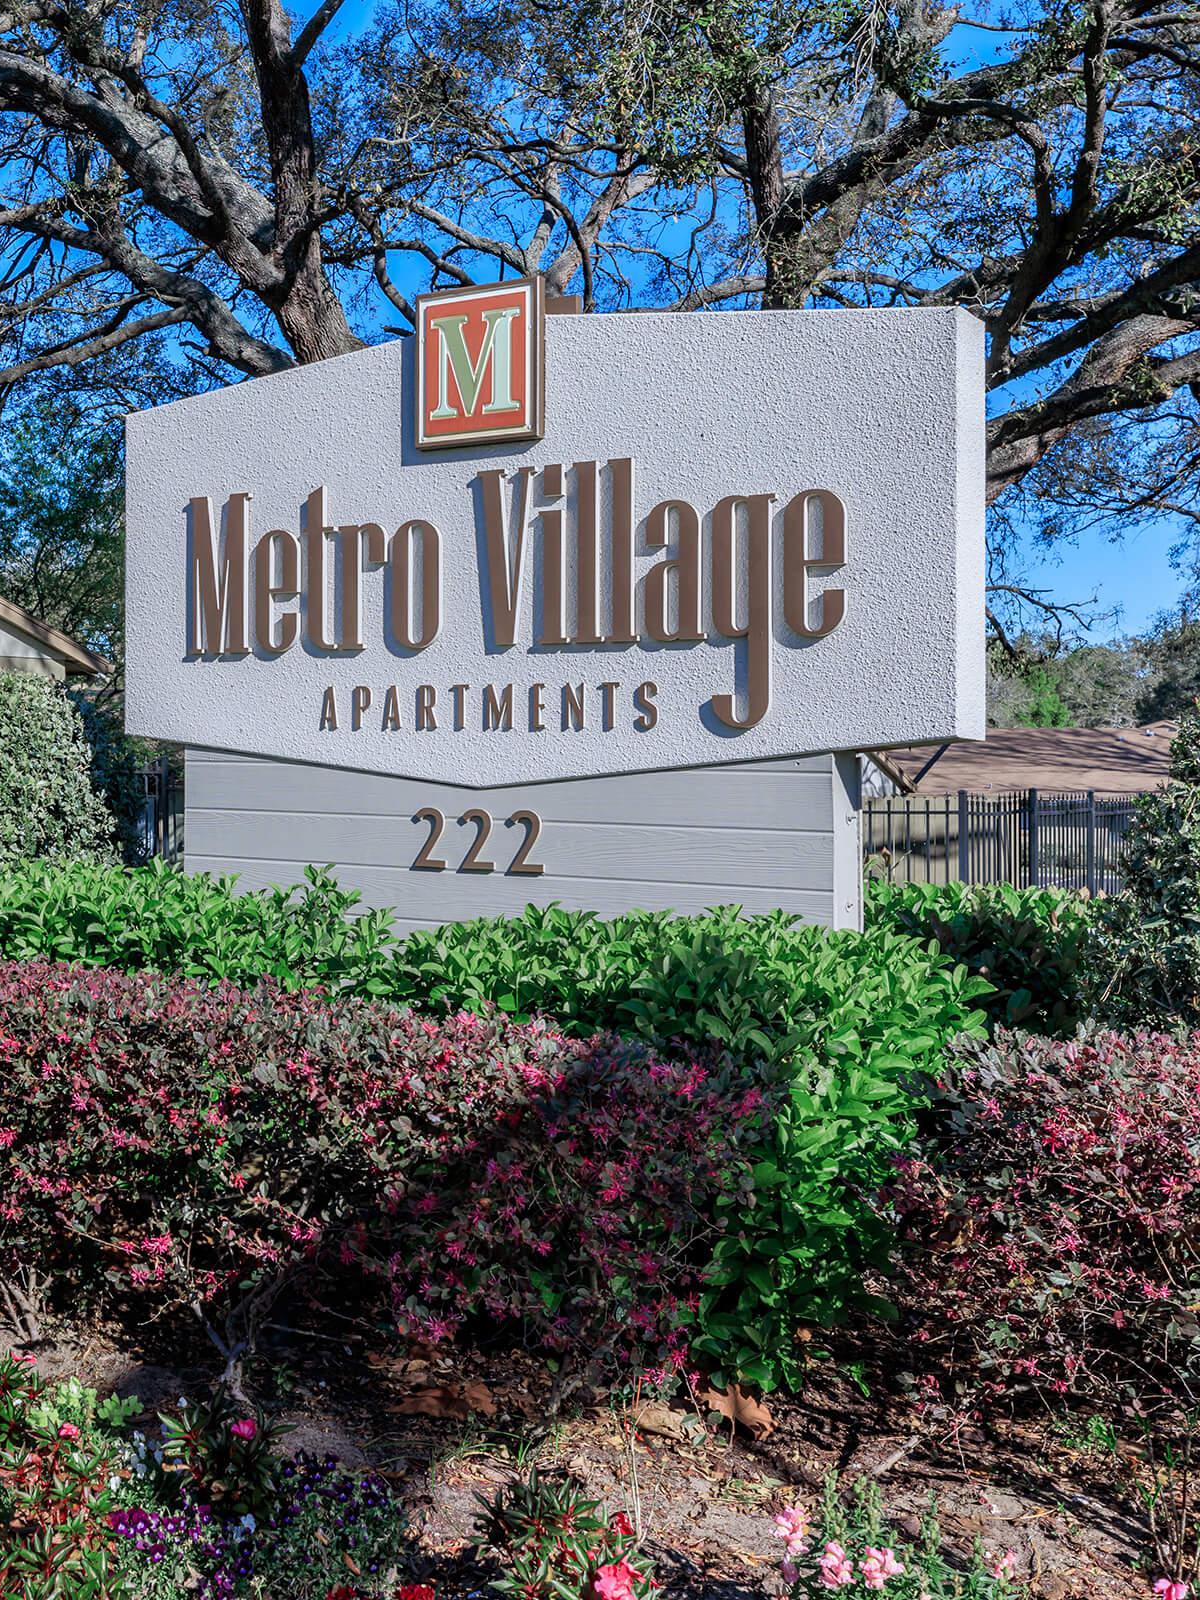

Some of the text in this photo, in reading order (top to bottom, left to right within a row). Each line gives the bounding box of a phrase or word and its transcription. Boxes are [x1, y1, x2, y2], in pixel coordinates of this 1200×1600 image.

[430, 307, 521, 421] M
[186, 457, 849, 730] Metro Village
[321, 680, 659, 732] APARTMENTS
[410, 807, 546, 874] 222
